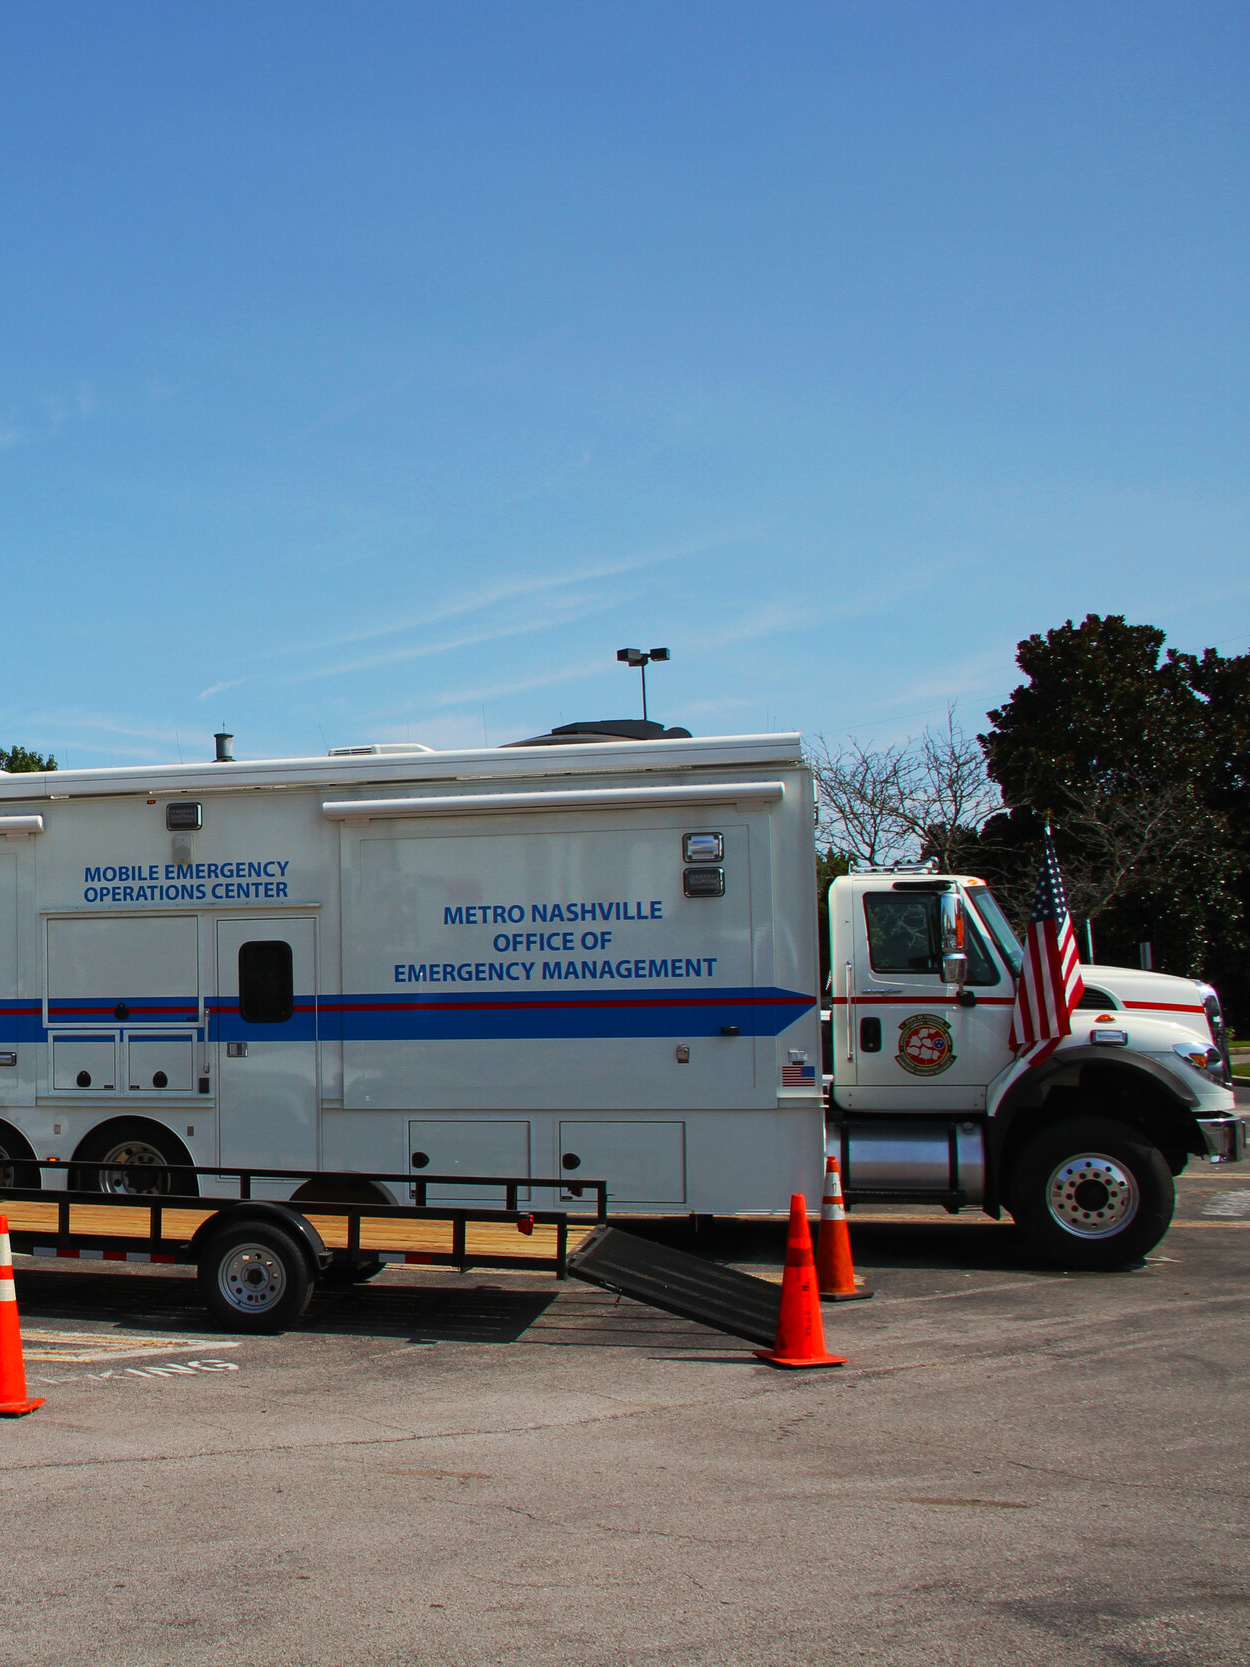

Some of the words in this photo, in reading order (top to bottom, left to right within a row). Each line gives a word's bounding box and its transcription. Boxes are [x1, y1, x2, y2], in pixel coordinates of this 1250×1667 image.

[85, 866, 159, 882] MOBILE
[165, 861, 289, 879] EMERGENCY
[84, 884, 206, 903] OPERATIONS
[212, 882, 288, 898] CENTER
[444, 905, 524, 924] METRO
[531, 901, 663, 922] NASHVILLE
[493, 932, 574, 952] OFFICE
[581, 931, 612, 949] OF
[394, 962, 535, 983] EMERGENCY
[542, 958, 717, 980] MANAGEMENT
